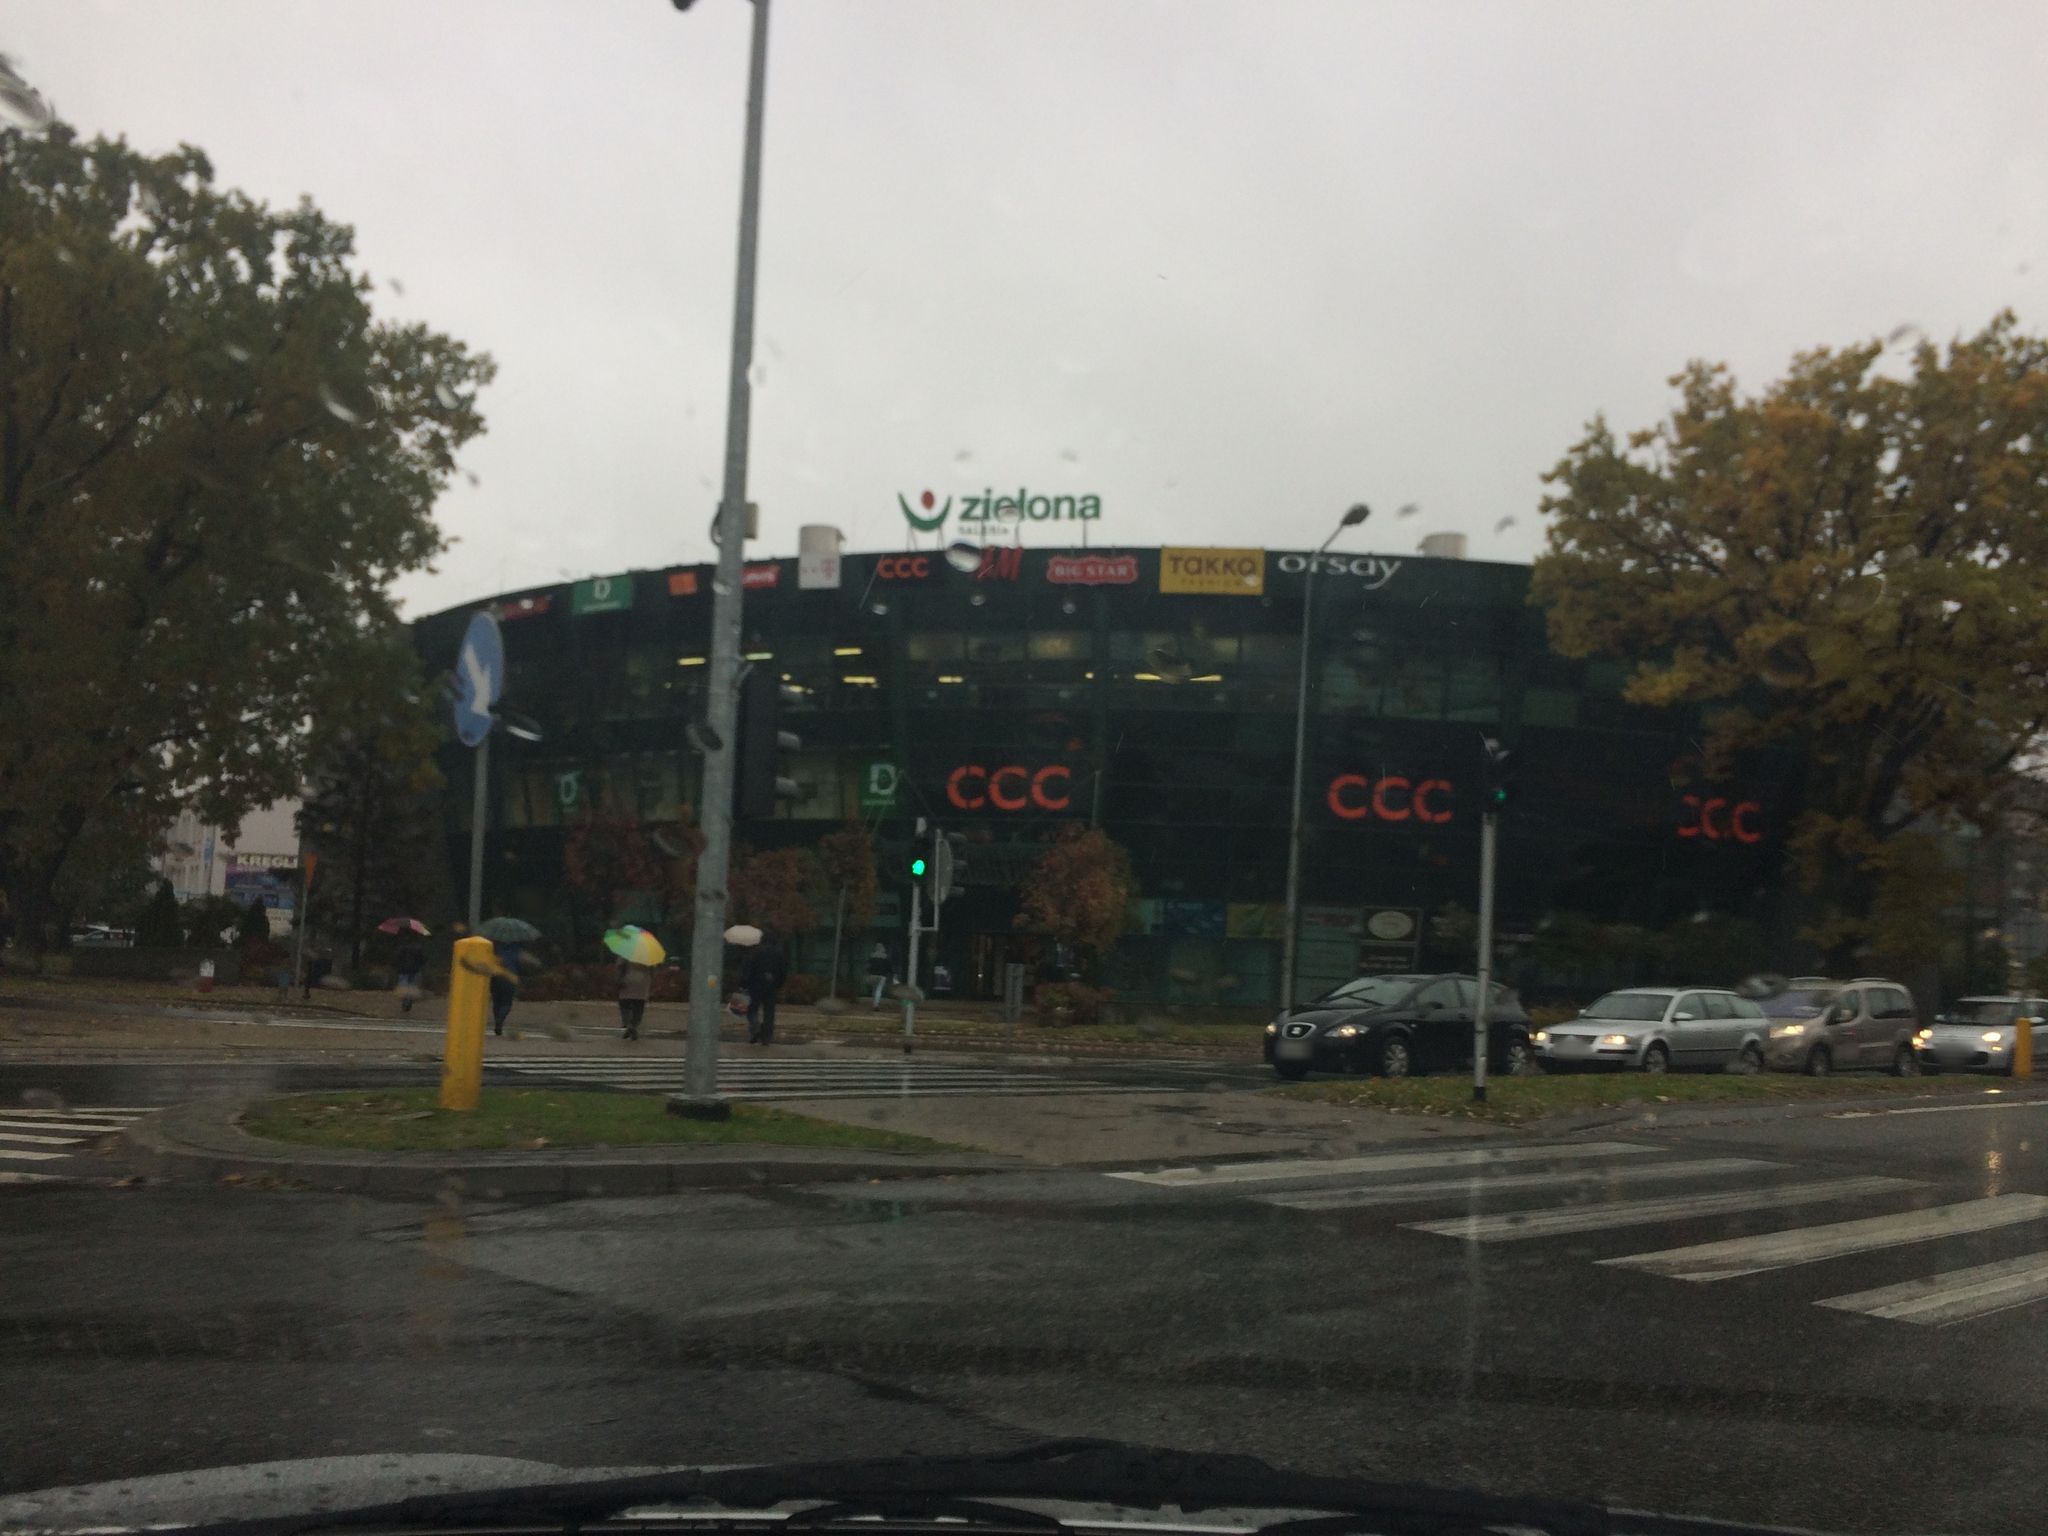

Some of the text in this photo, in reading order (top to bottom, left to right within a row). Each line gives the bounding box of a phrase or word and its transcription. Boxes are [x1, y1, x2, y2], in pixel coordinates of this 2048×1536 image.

[958, 487, 1102, 521] zielona
[878, 557, 929, 579] CCC
[1055, 564, 1128, 577] BIG STAR
[1278, 553, 1400, 590] orsay
[946, 764, 1071, 811] CCC
[1327, 774, 1454, 824] CCC
